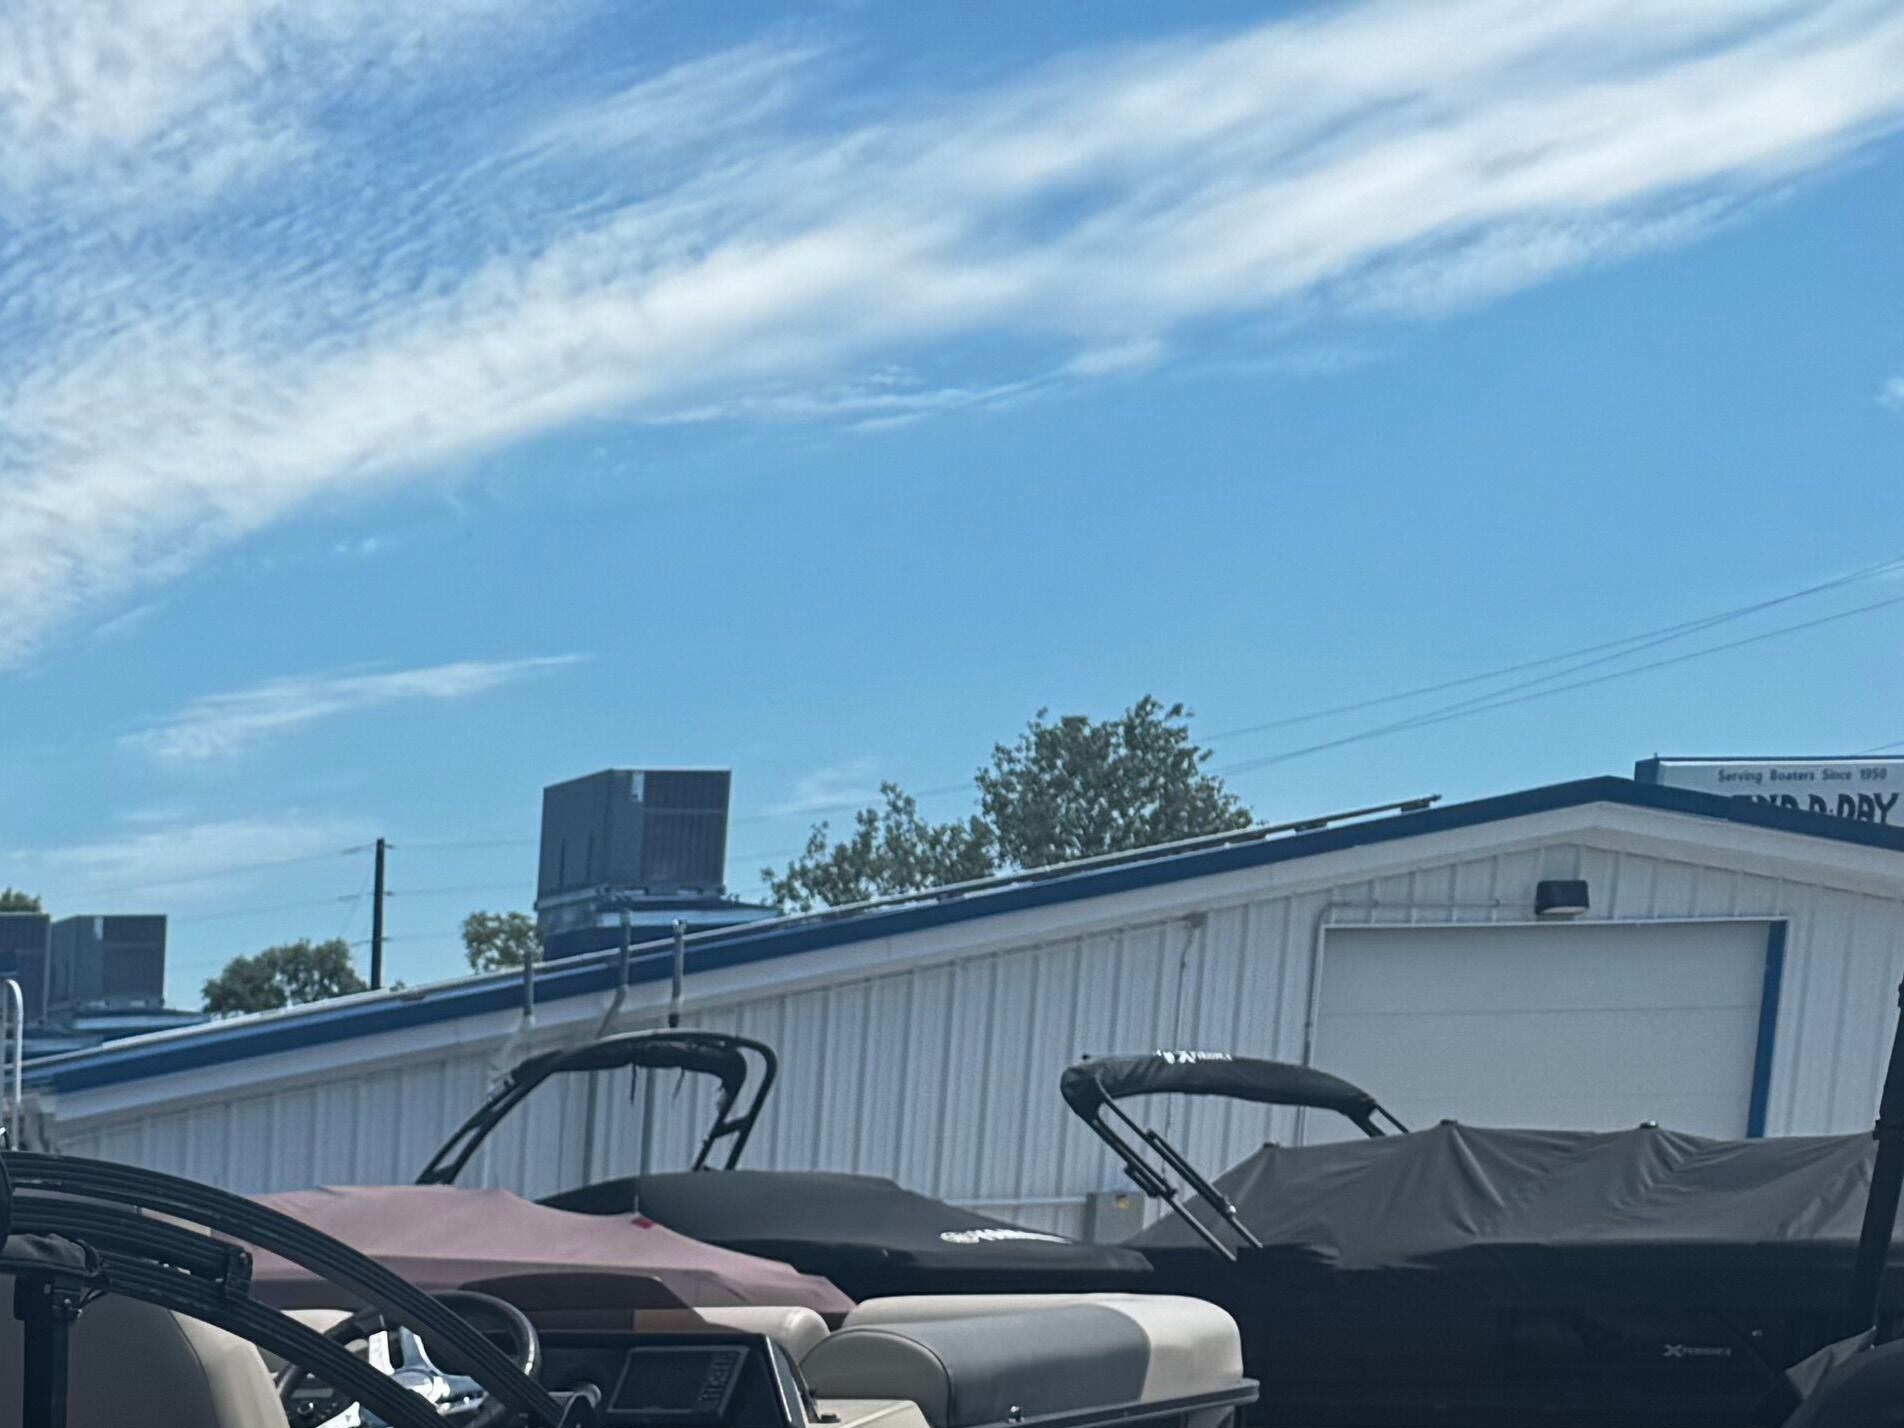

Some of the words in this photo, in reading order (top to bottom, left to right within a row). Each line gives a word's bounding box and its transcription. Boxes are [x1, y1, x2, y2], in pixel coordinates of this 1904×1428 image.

[1718, 769, 1762, 785] Serving
[1770, 768, 1815, 781] Boaters
[1822, 768, 1852, 781] Since
